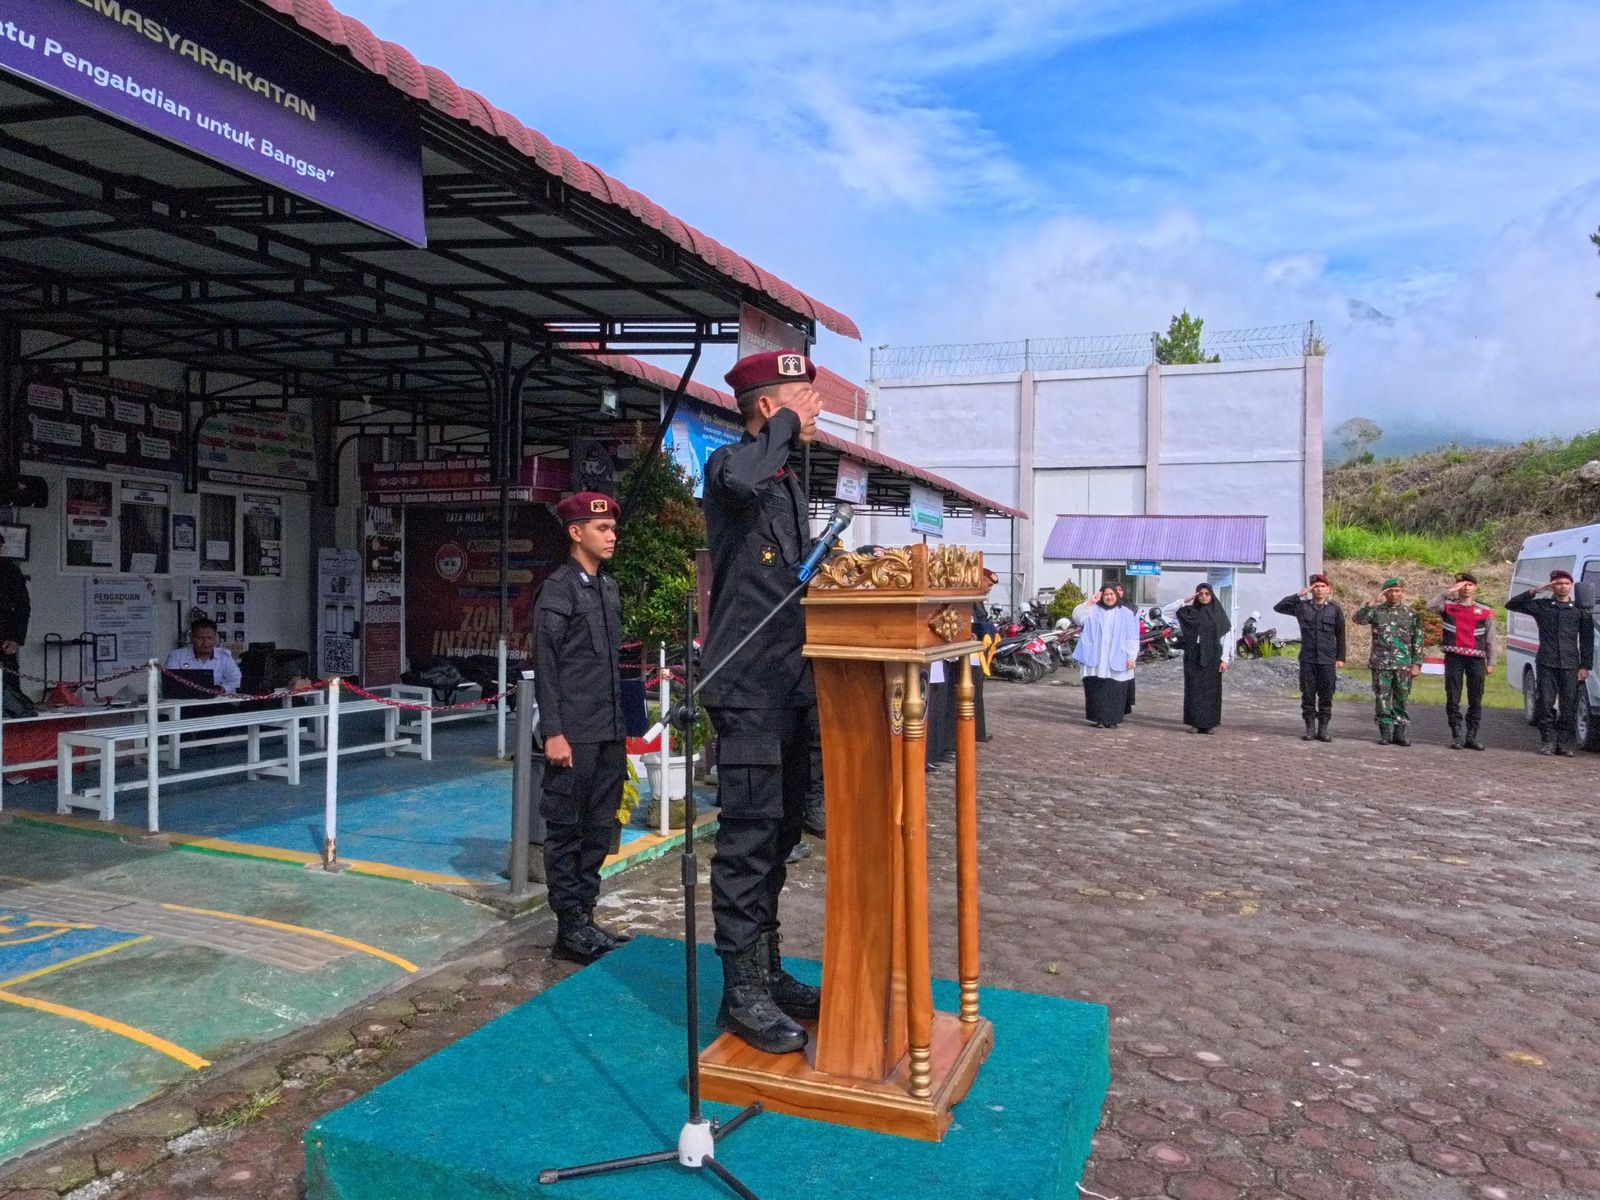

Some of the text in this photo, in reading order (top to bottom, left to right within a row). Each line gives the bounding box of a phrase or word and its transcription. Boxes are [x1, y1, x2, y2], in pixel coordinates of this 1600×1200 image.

[78, 0, 316, 121] MASYARAKATAN
[44, 37, 191, 120] Pengabdian
[197, 111, 255, 150] untuk
[506, 489, 528, 500] eriah
[94, 593, 140, 601] PENGADUAN
